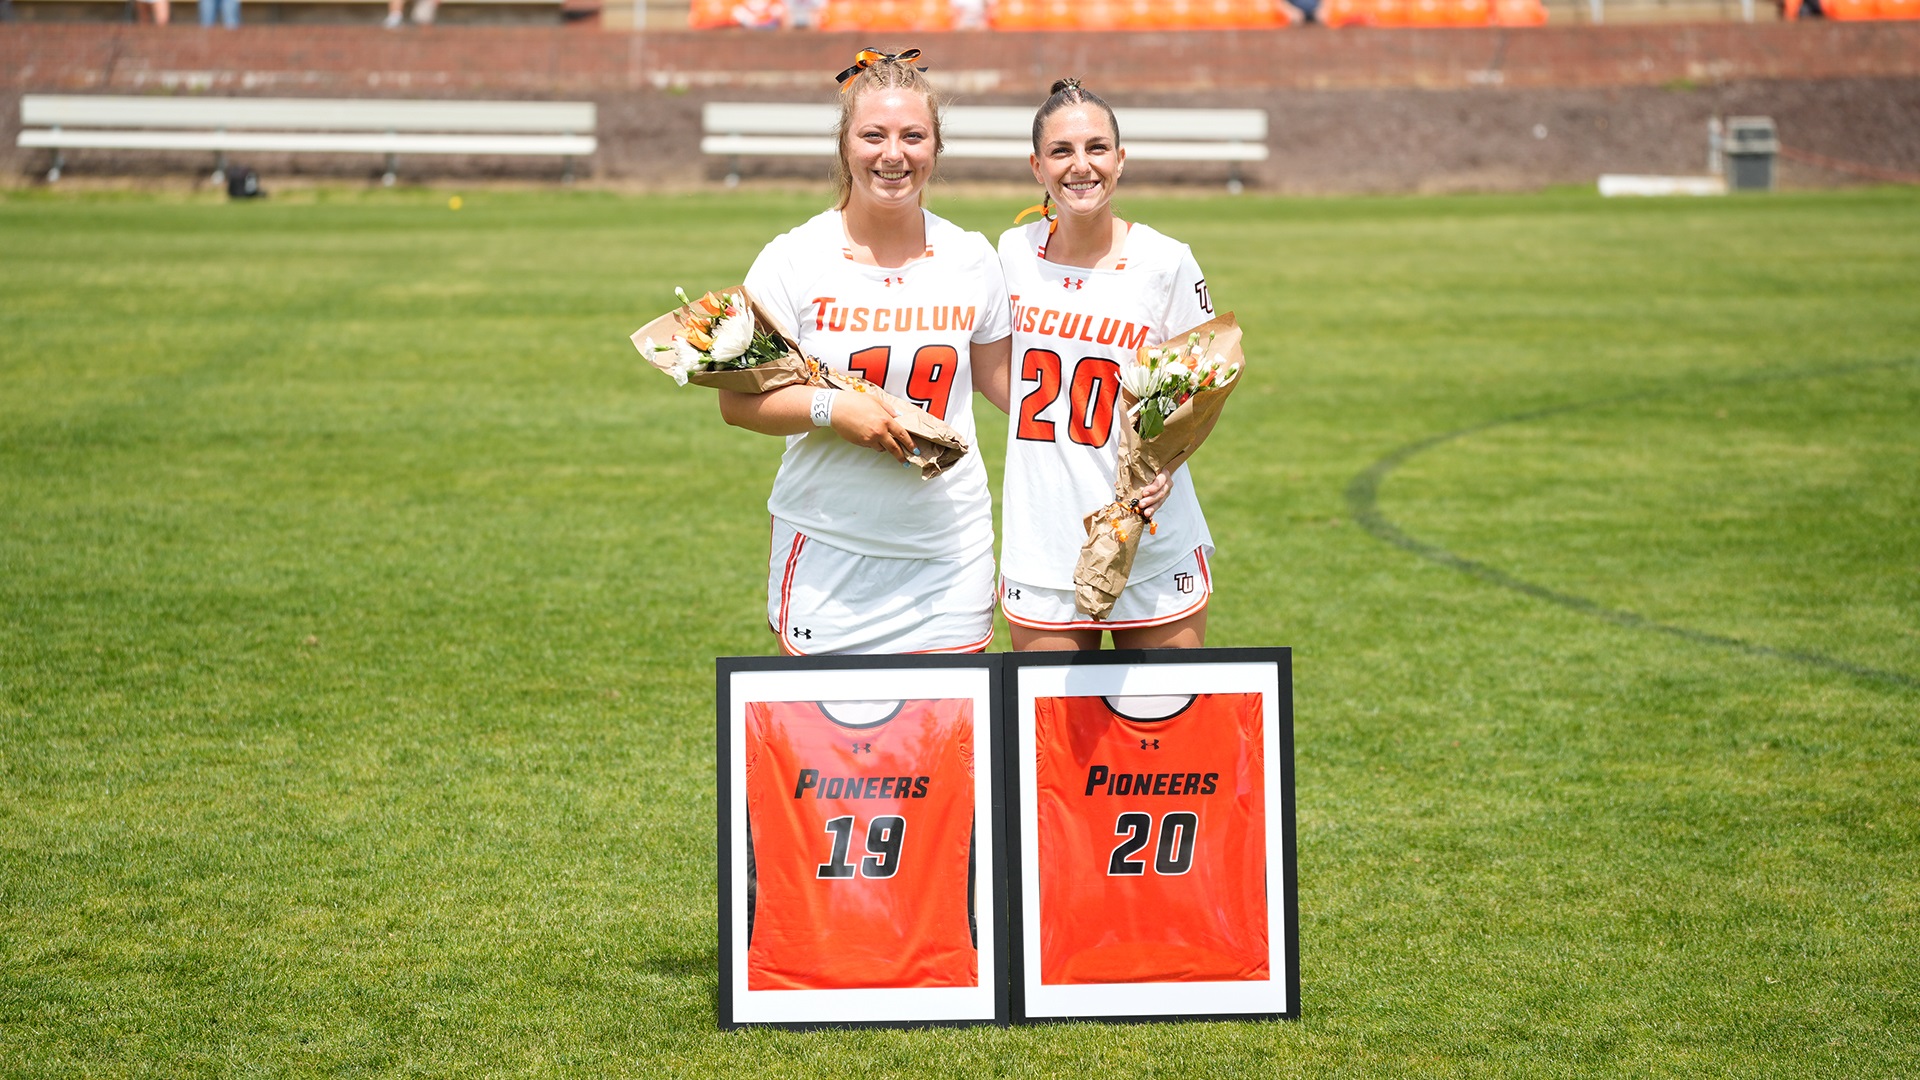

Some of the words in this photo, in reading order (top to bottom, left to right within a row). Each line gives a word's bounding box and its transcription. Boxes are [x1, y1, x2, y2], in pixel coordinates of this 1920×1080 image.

[811, 296, 976, 332] TUSCULUM
[1016, 348, 1121, 449] 20
[1174, 571, 1194, 594] TU
[794, 768, 930, 799] PIONEERS
[1084, 765, 1219, 796] PIONEERS
[816, 814, 907, 879] 19
[1107, 811, 1199, 876] 20
